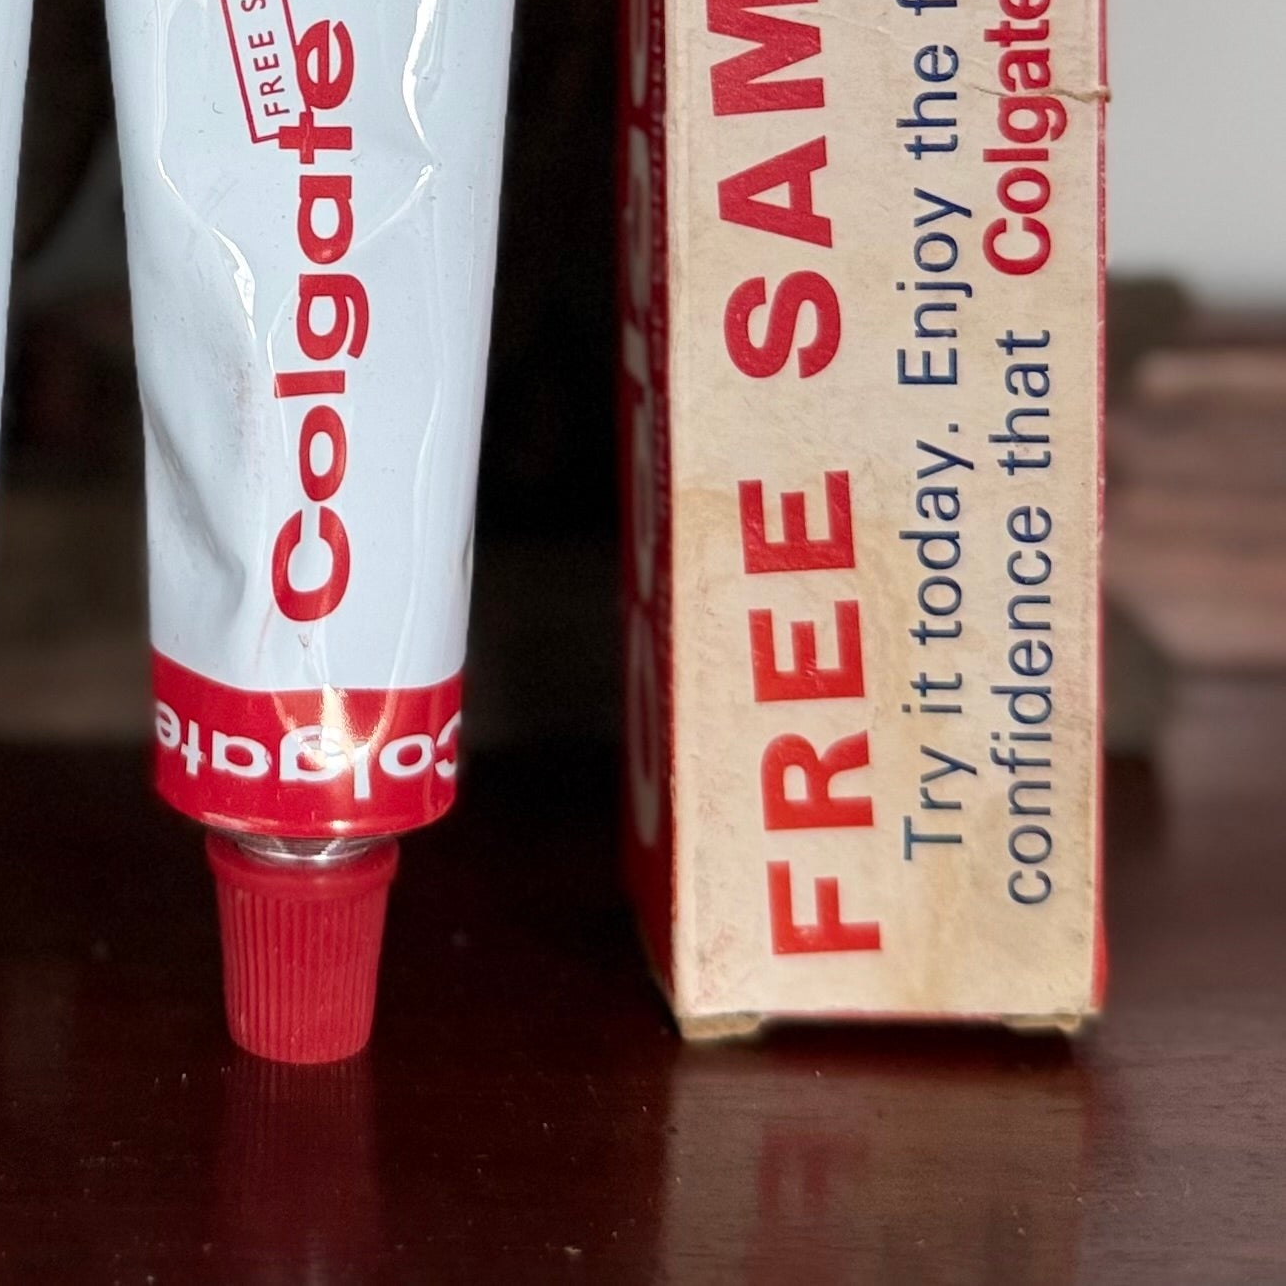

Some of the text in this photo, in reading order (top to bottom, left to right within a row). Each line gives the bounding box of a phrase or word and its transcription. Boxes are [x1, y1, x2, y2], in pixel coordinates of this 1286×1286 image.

[247, 30, 290, 117] FREE
[897, 45, 960, 159] the
[271, 20, 369, 622] Colgate
[897, 187, 972, 385] Enjoy
[989, 329, 1051, 475] that
[900, 423, 974, 646] today.
[738, 470, 882, 956] FREE
[902, 673, 963, 715] it
[989, 505, 1053, 906] confidence
[903, 744, 977, 861] Try
